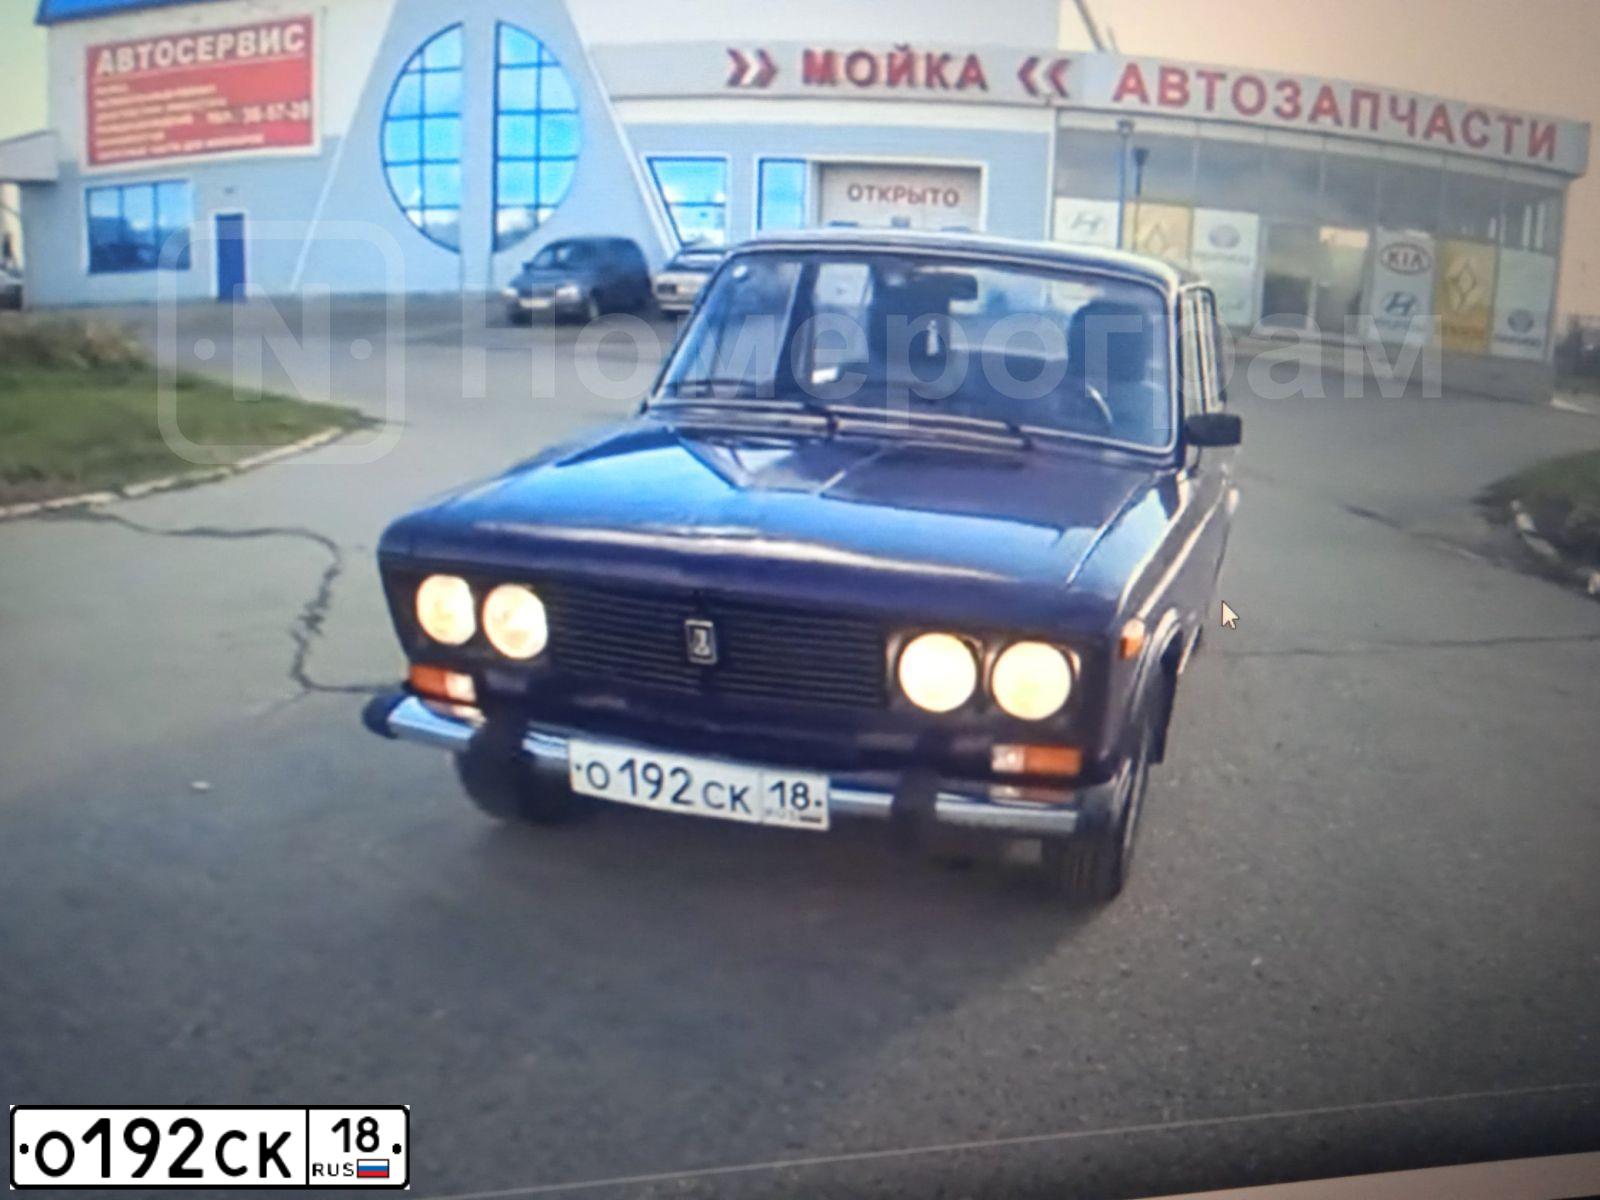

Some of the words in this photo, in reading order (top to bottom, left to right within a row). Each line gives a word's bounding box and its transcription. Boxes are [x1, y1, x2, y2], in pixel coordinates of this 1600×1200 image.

[95, 23, 305, 75] АВТОСЕРВИС
[802, 43, 988, 91] МОЙКА
[1112, 63, 1558, 162] АВТОЗАПЧАСТИ
[847, 183, 960, 207] ОТКРЫТО
[1386, 250, 1424, 268] KIA
[768, 780, 811, 811] 18
